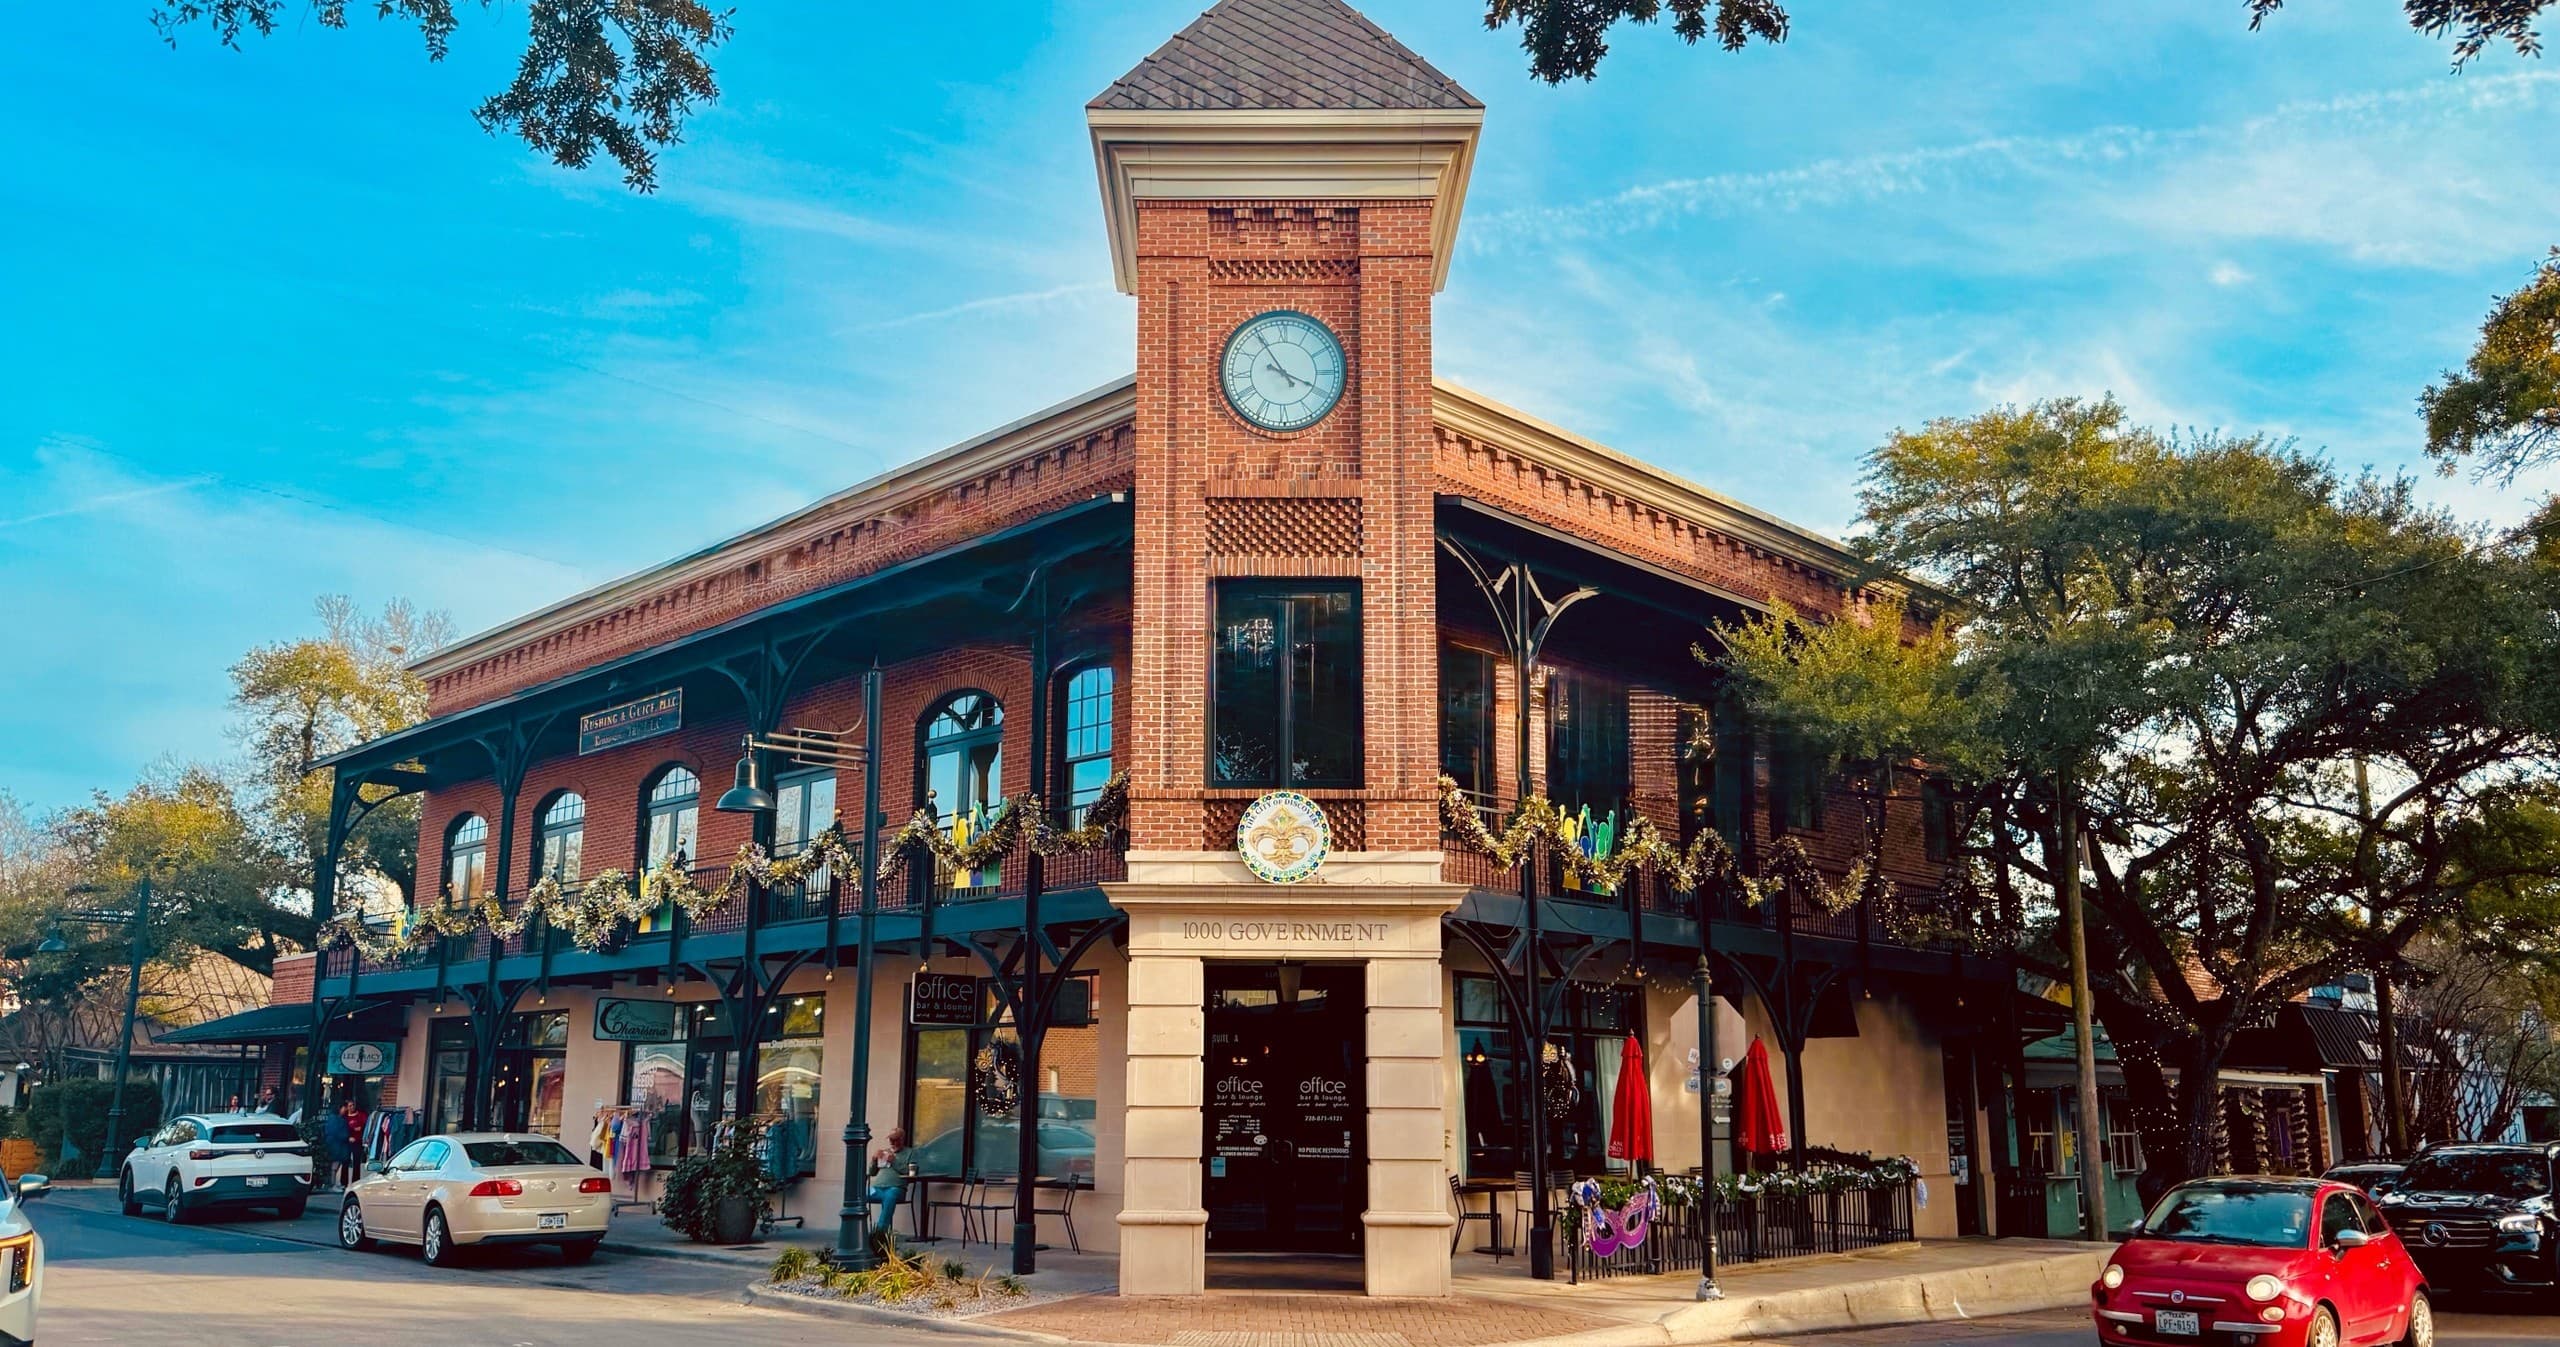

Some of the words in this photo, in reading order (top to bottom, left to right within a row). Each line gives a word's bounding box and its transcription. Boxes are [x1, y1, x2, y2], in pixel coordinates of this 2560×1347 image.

[1246, 815, 1257, 829] THE
[1255, 801, 1272, 815] CITY
[1284, 799, 1320, 828] DISCOVERY
[1184, 922, 1222, 939] 1000
[1229, 923, 1388, 941] GOVERNMENT
[917, 976, 973, 1001] office
[943, 1002, 973, 1012] lounge
[635, 1047, 648, 1059] THE
[1216, 1076, 1263, 1093] office
[1300, 1076, 1346, 1094] office
